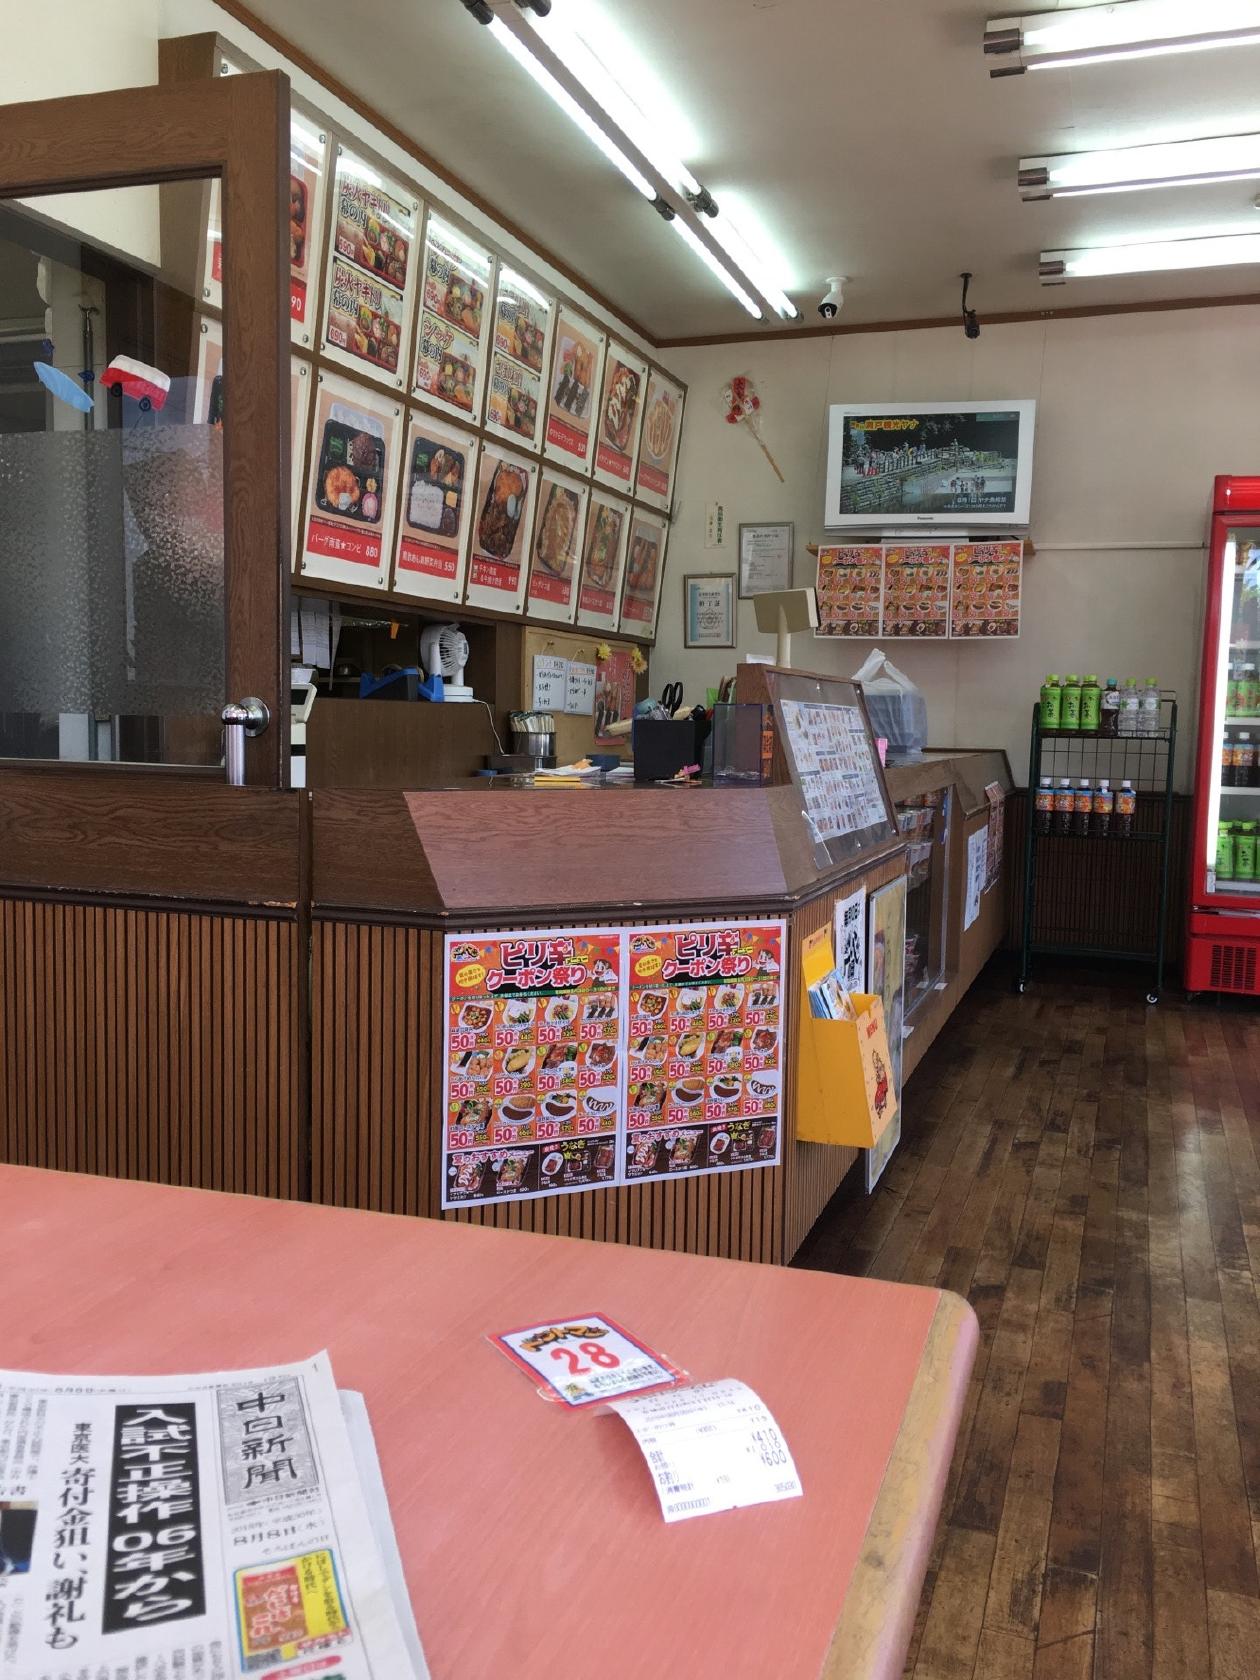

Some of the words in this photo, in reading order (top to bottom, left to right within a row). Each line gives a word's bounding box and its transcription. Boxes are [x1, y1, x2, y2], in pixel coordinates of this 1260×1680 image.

[499, 937, 574, 970] ピリ辛
[674, 929, 740, 959] ピリ辛
[487, 965, 588, 991] クーポン祭り
[662, 955, 753, 980] クーポン祭り
[550, 1341, 621, 1377] 28
[70, 1422, 93, 1465] 東京医大
[236, 1390, 298, 1490] 中日新聞
[117, 1408, 193, 1525] 入試不正操作
[760, 1449, 787, 1466] ¥600
